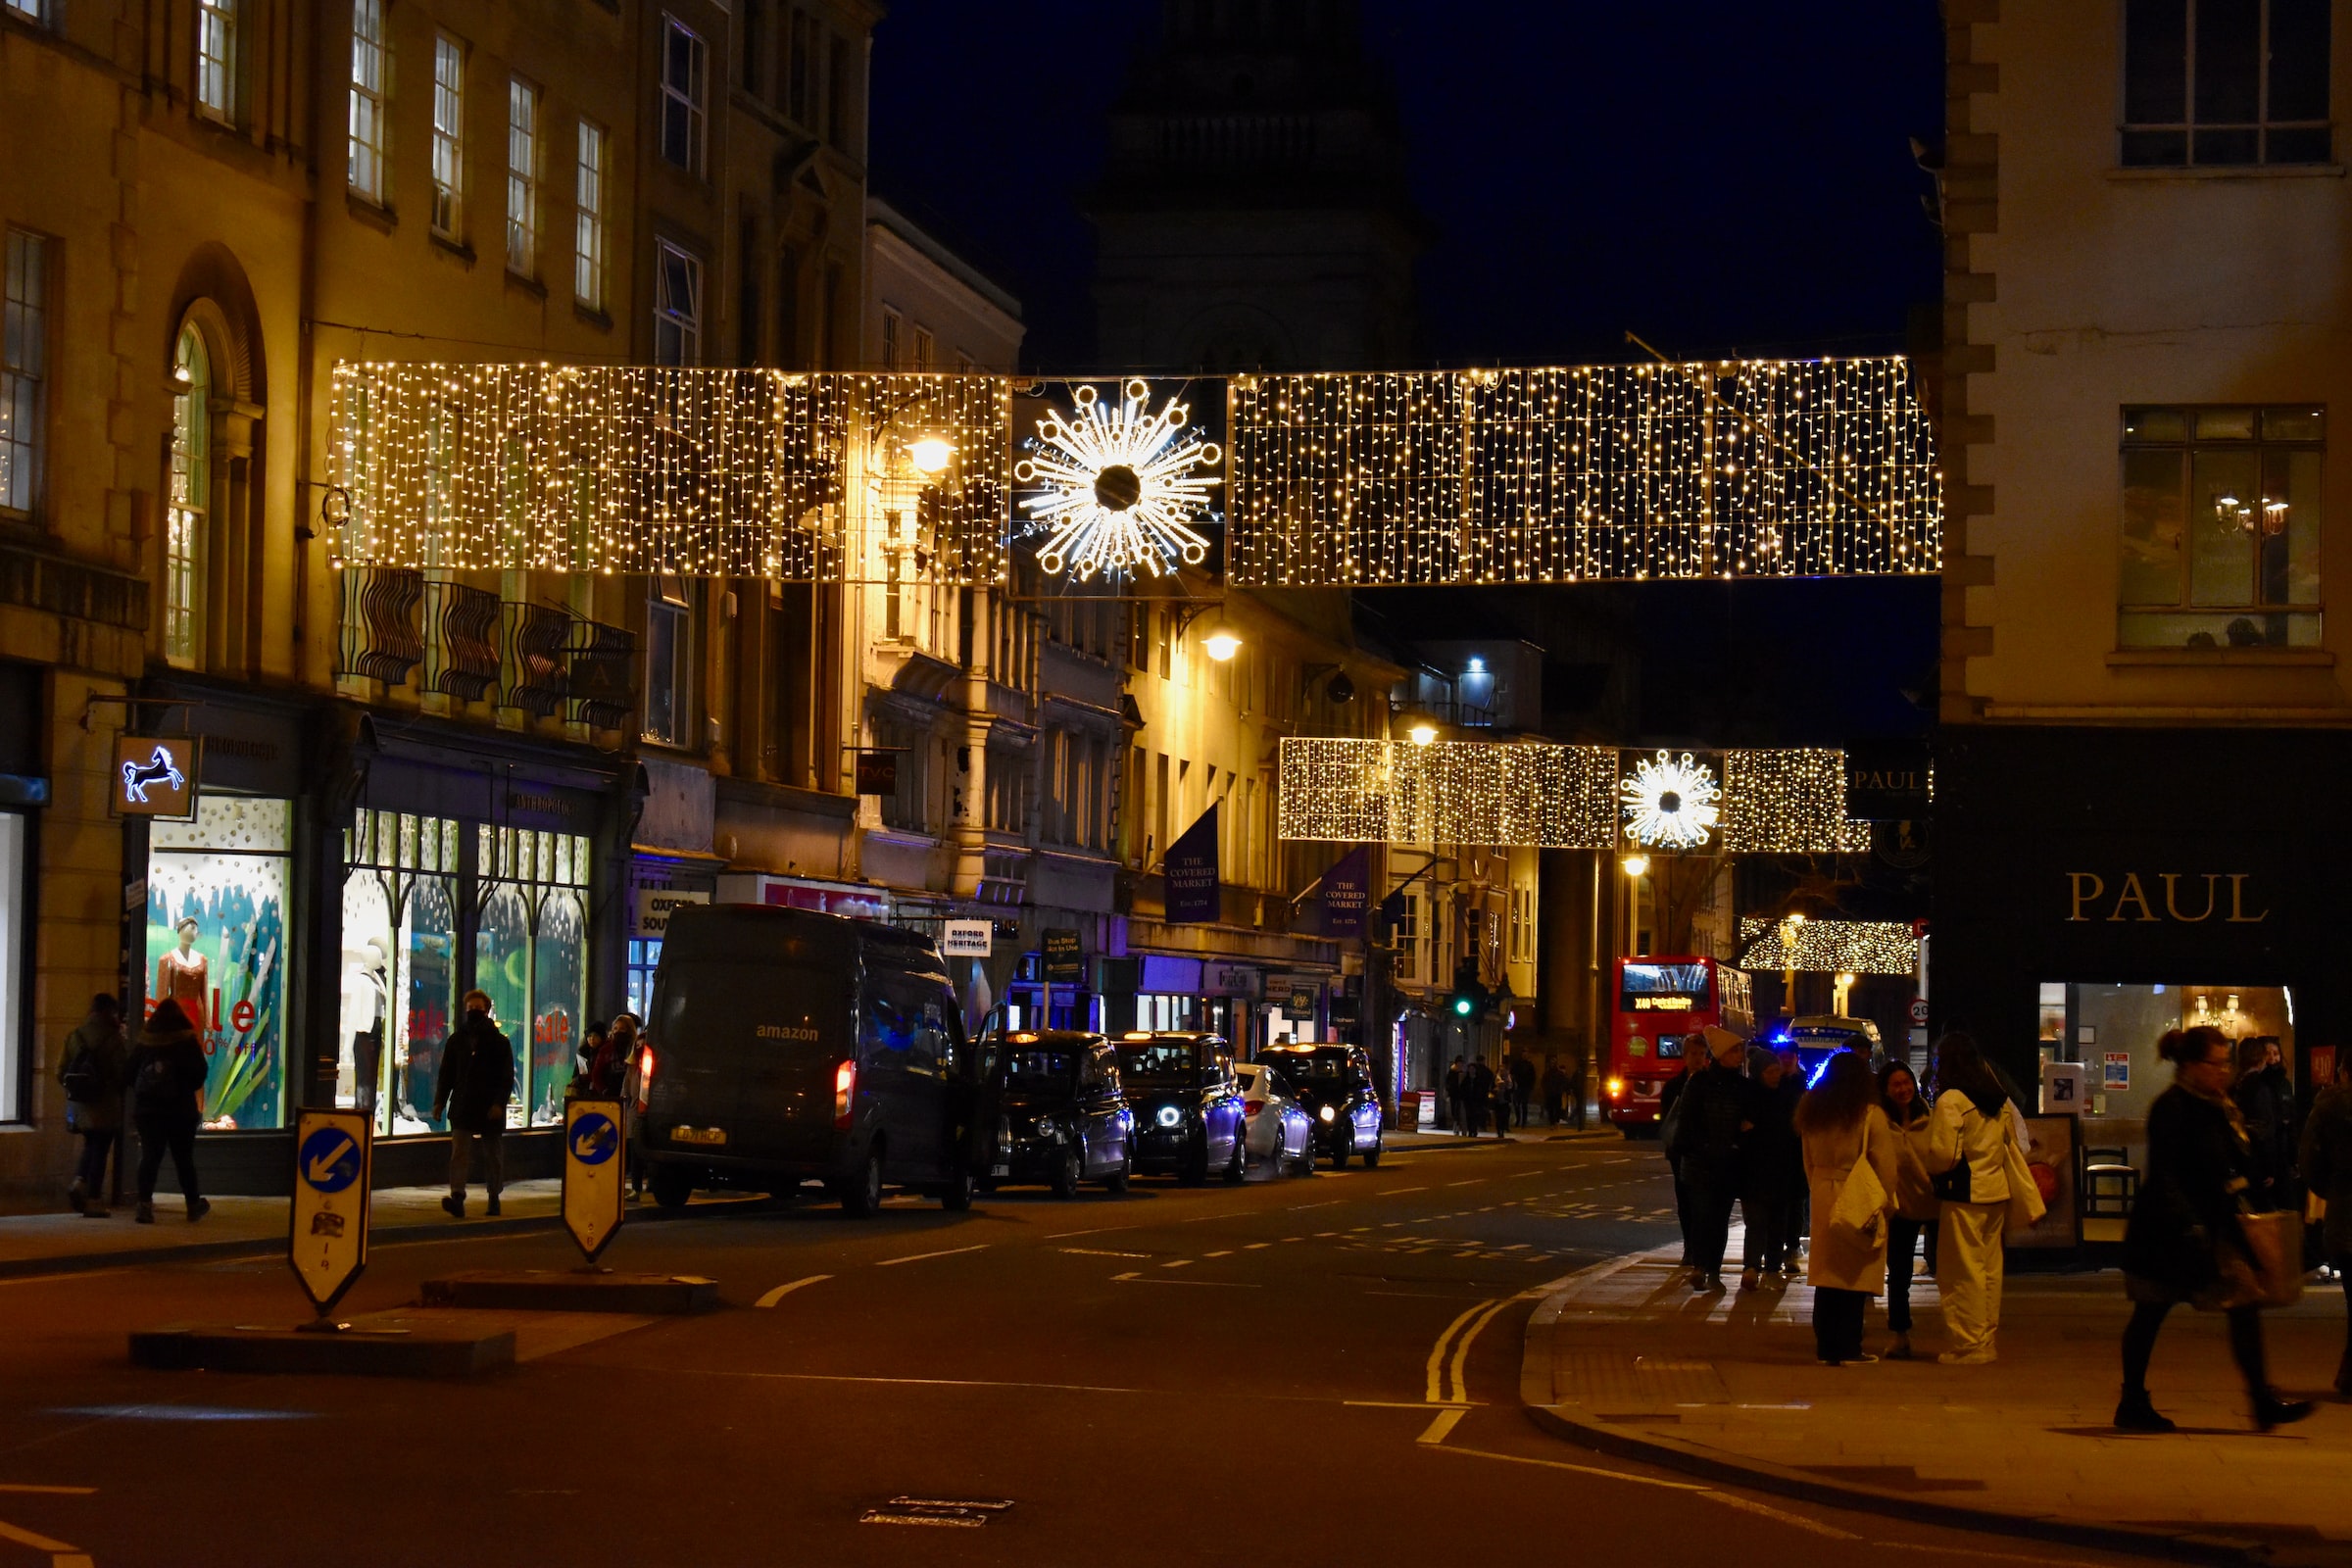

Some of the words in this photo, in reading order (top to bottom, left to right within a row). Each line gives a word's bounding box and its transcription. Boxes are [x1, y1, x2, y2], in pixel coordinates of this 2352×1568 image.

[1853, 770, 1923, 790] PAUL
[1169, 867, 1216, 878] COVERED
[1172, 878, 1213, 888] MARKET
[1325, 891, 1366, 900] COVERED
[1328, 901, 1363, 909] MARKET
[2065, 871, 2270, 923] PAUL
[408, 1001, 445, 1041] sale
[535, 1006, 568, 1044] sale
[757, 1024, 819, 1043] amazon
